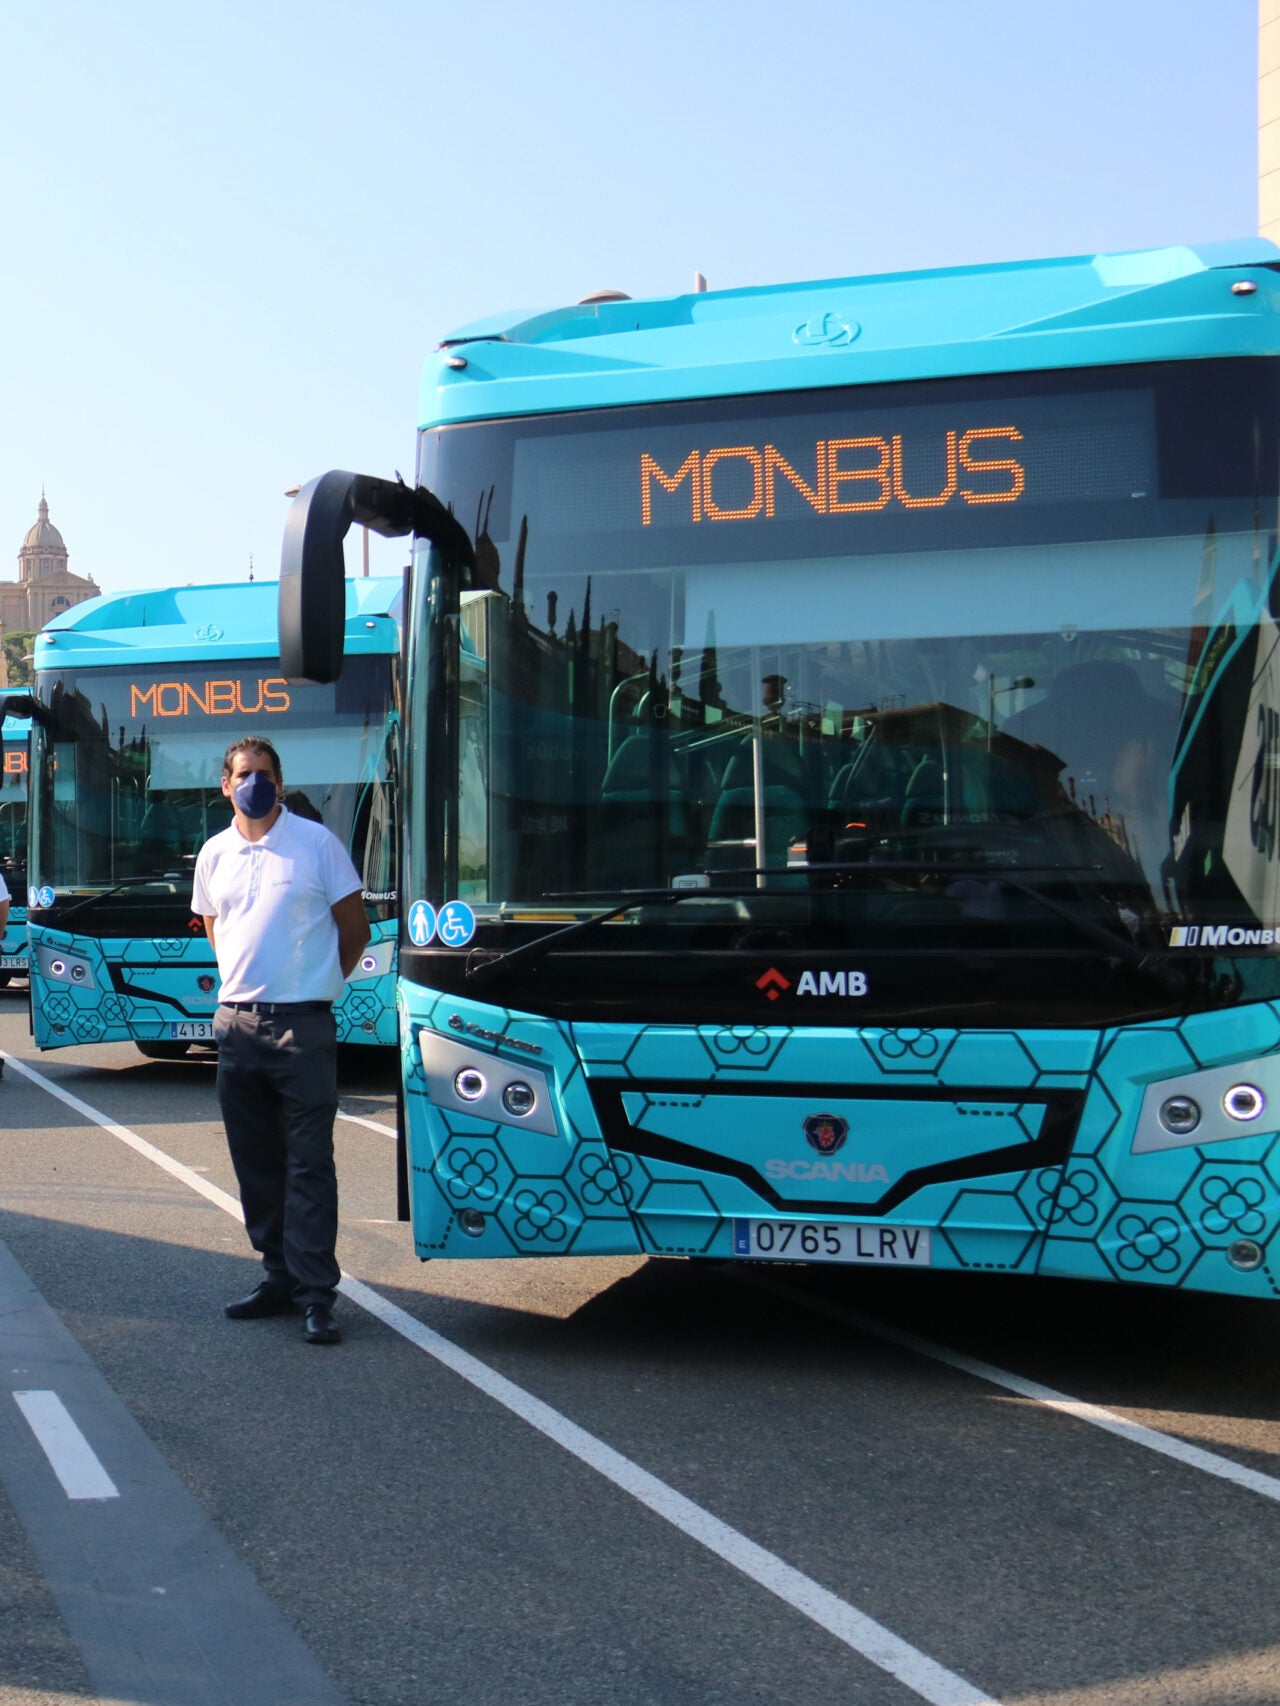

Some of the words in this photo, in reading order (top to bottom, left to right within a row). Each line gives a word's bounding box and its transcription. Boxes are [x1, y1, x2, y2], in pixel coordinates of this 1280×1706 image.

[641, 426, 1024, 525] MONBUS
[130, 678, 291, 718] MONBUS
[1200, 925, 1280, 946] MONB
[796, 971, 868, 997] AMB
[765, 1158, 890, 1183] SCANIA
[739, 1239, 746, 1249] E
[756, 1223, 841, 1255] 0765
[856, 1227, 920, 1259] LRV
